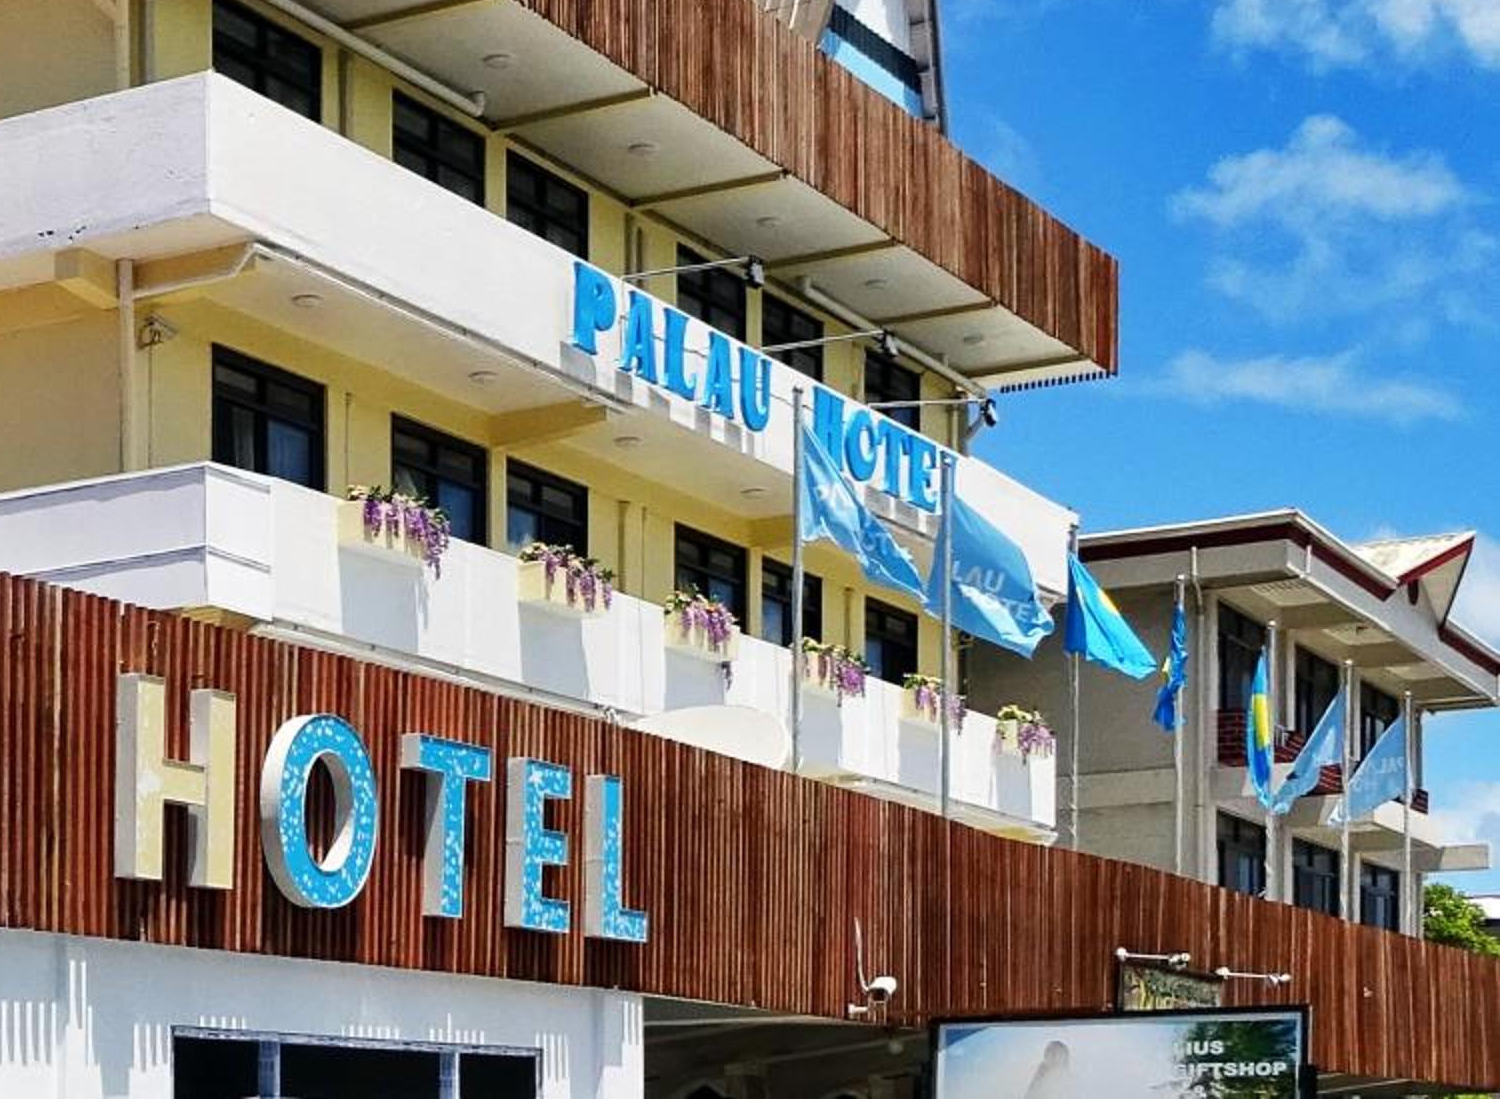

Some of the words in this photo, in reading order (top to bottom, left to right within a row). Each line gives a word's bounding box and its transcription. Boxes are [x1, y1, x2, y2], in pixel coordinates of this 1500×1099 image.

[573, 261, 772, 431] PALAU
[813, 386, 945, 514] HOTE
[114, 672, 648, 943] HOTEL
